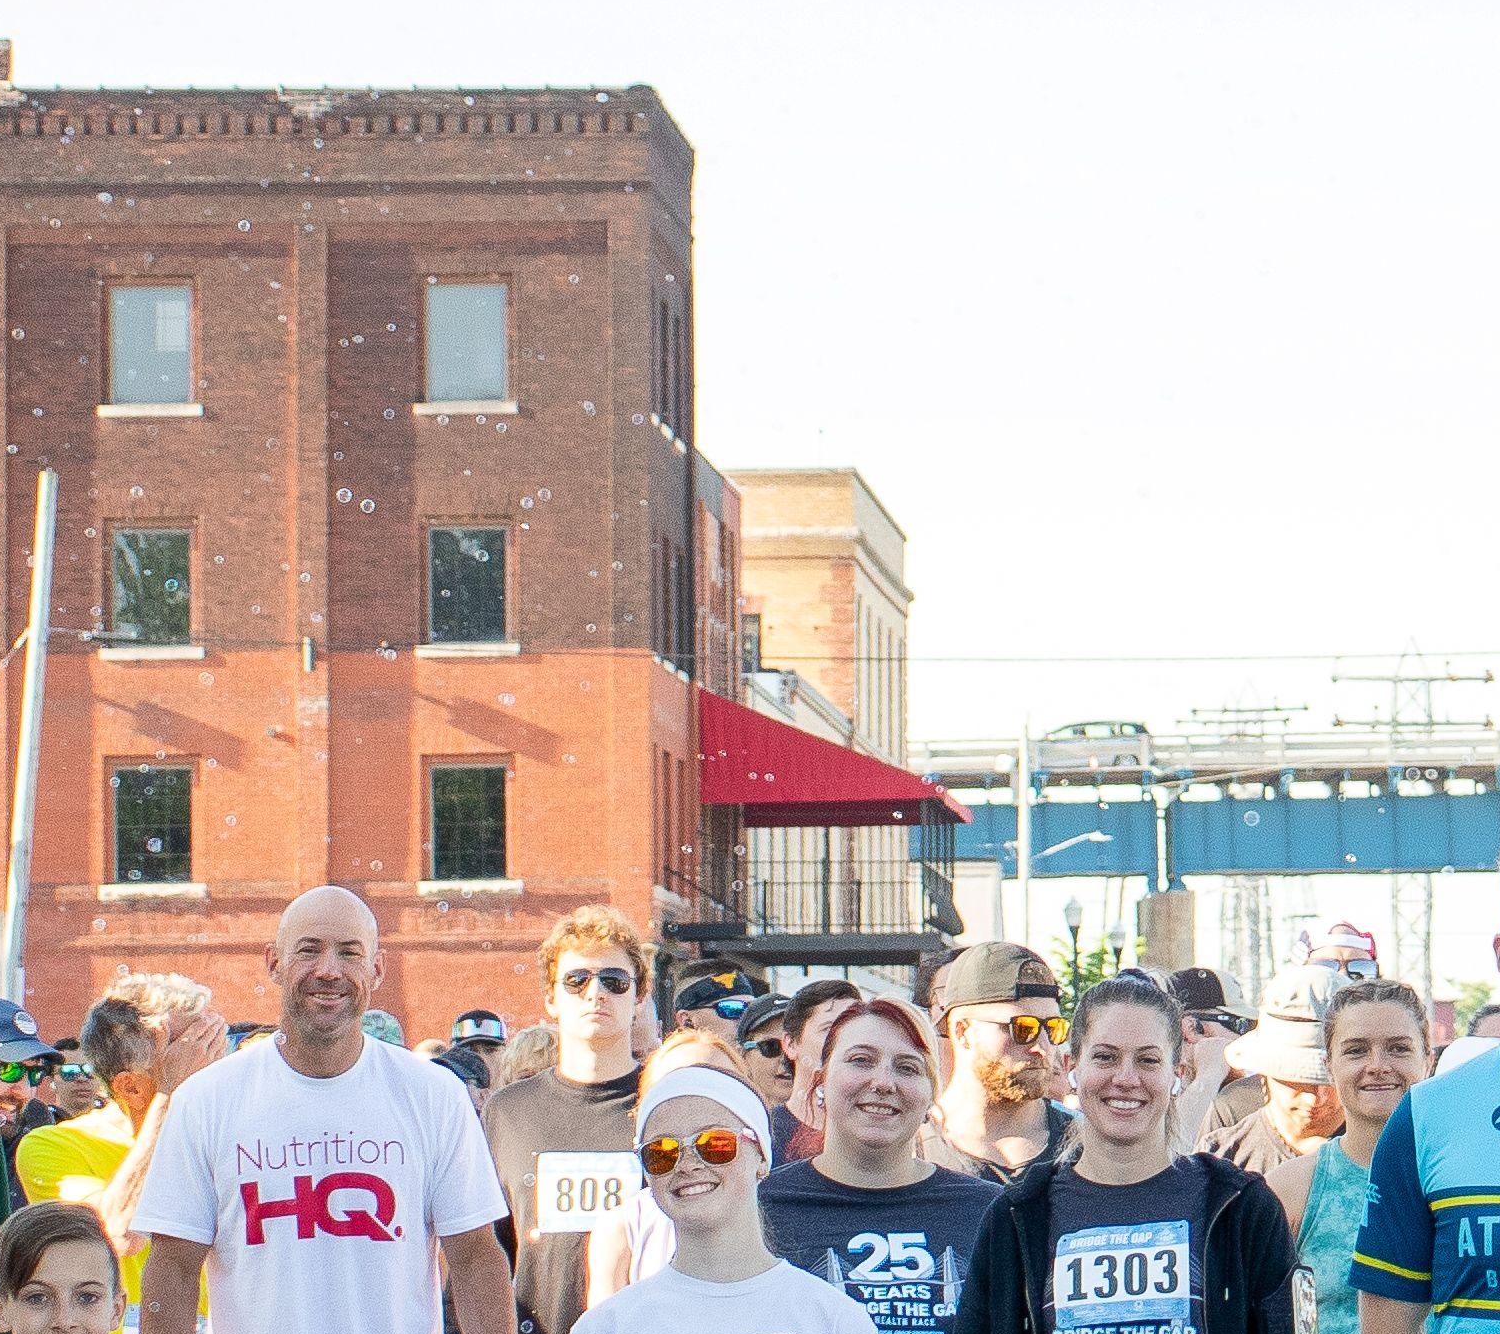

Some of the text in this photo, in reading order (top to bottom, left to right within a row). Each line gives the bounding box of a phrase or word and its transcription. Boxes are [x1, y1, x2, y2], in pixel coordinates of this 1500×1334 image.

[236, 1131, 404, 1175] Nutrition
[557, 1177, 623, 1212] 808
[847, 1232, 935, 1281] 25
[1069, 1232, 1153, 1248] BRIDGE THE GAP
[857, 1284, 932, 1300] YEARS
[1066, 1249, 1179, 1302] 1303
[893, 1302, 931, 1316] THE
[933, 1303, 957, 1317] GA
